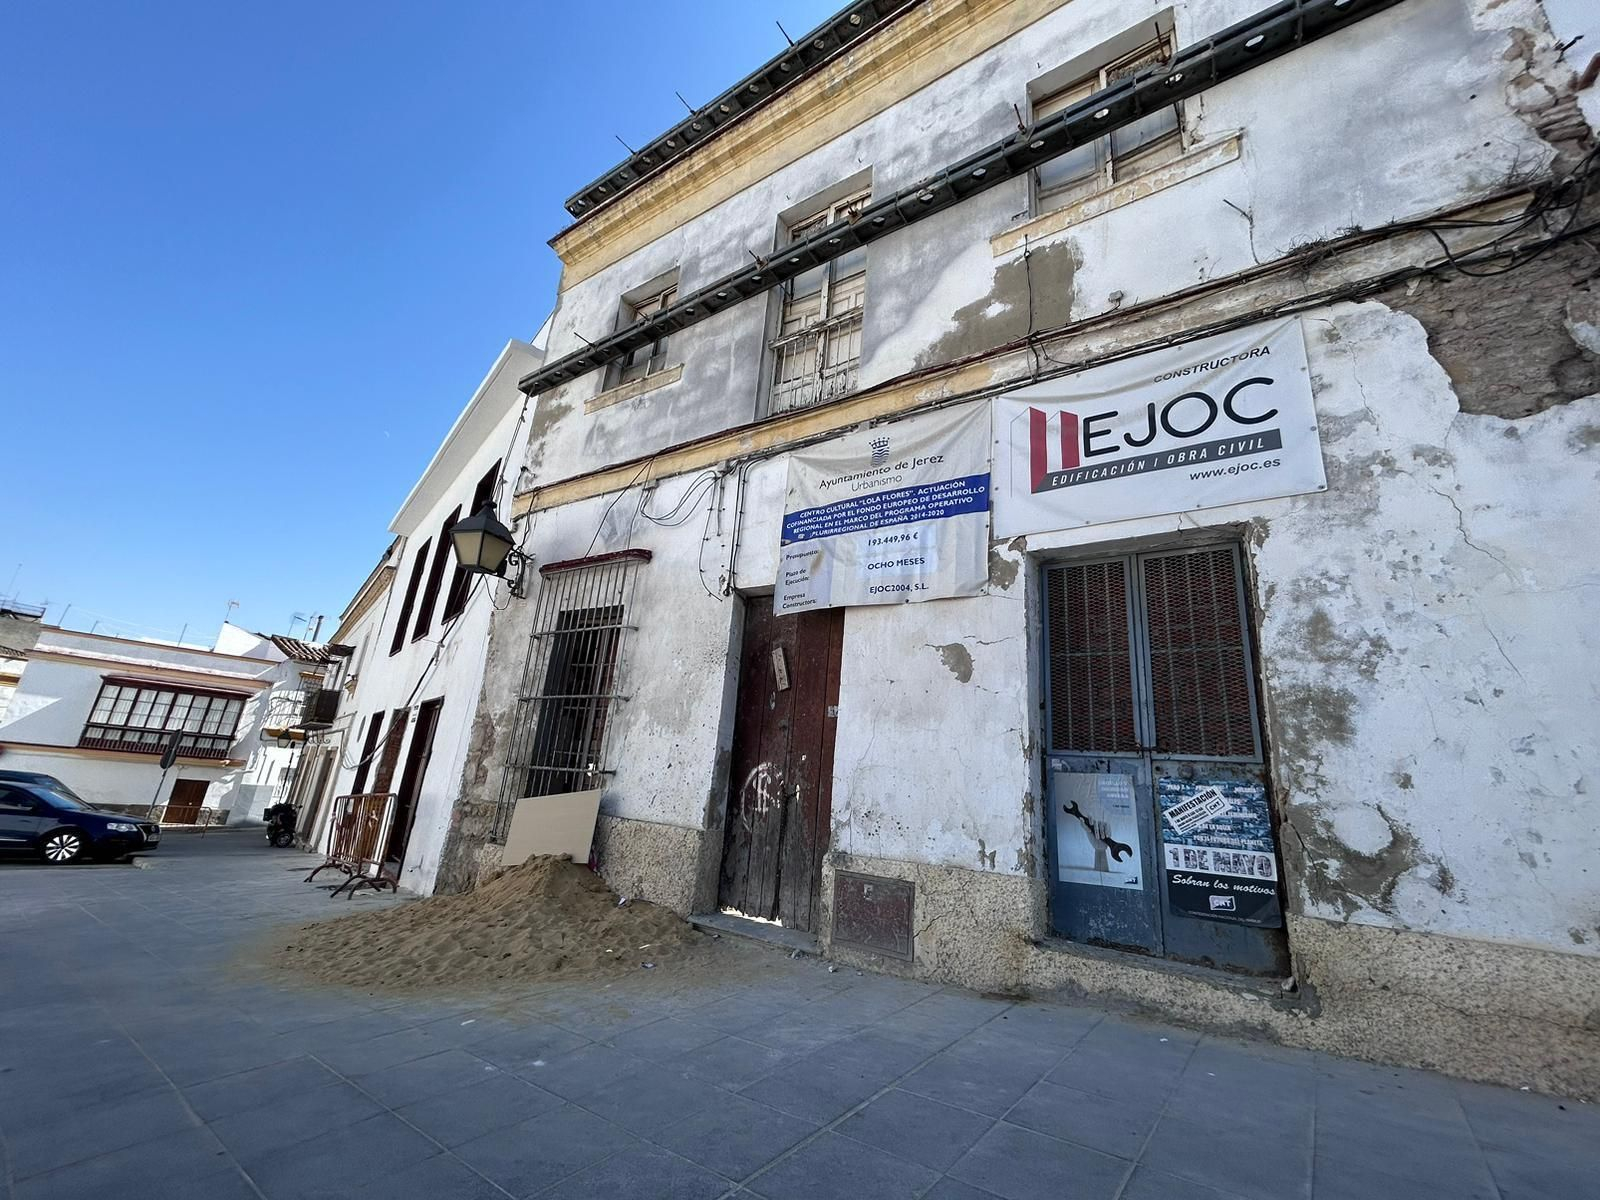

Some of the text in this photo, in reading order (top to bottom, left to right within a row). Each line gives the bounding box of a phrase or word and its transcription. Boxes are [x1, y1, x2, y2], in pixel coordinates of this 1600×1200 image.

[1154, 346, 1270, 383] CONSTRUCTORA
[1082, 376, 1278, 457] EJOC
[818, 455, 944, 491] Ayuntamiento de Jerez
[1051, 459, 1146, 487] EDIFICACIÓN
[1167, 447, 1208, 465] OBRA
[1217, 437, 1264, 456] CIVIL
[1189, 458, 1281, 481] www.ejoc.es
[851, 474, 903, 492] Urbanismo
[786, 514, 832, 529] COFINANCIADA
[833, 511, 847, 520] POR
[856, 504, 882, 515] FONDO
[883, 498, 919, 509] EUROPEO
[932, 486, 985, 501] DESARROLLO
[800, 508, 825, 519] CENTRO
[826, 501, 859, 514] CULTURAL
[917, 480, 966, 496] ACTUACIÓN
[793, 496, 974, 534] REGIONAL EN EL MARCO DEL PROGRAMA OPERATIVO
[869, 519, 879, 527] DE
[880, 513, 908, 525] ESPAÑA
[910, 509, 945, 521] 2014-2020
[868, 531, 919, 546] 193.449,96 €
[867, 557, 926, 570] OCHO MESES
[783, 592, 806, 601] Empresa
[869, 582, 929, 594] EJOC2004, S.L.
[1168, 847, 1273, 878] 1 DE MAYO
[1171, 874, 1276, 895] Sobran los motivos
